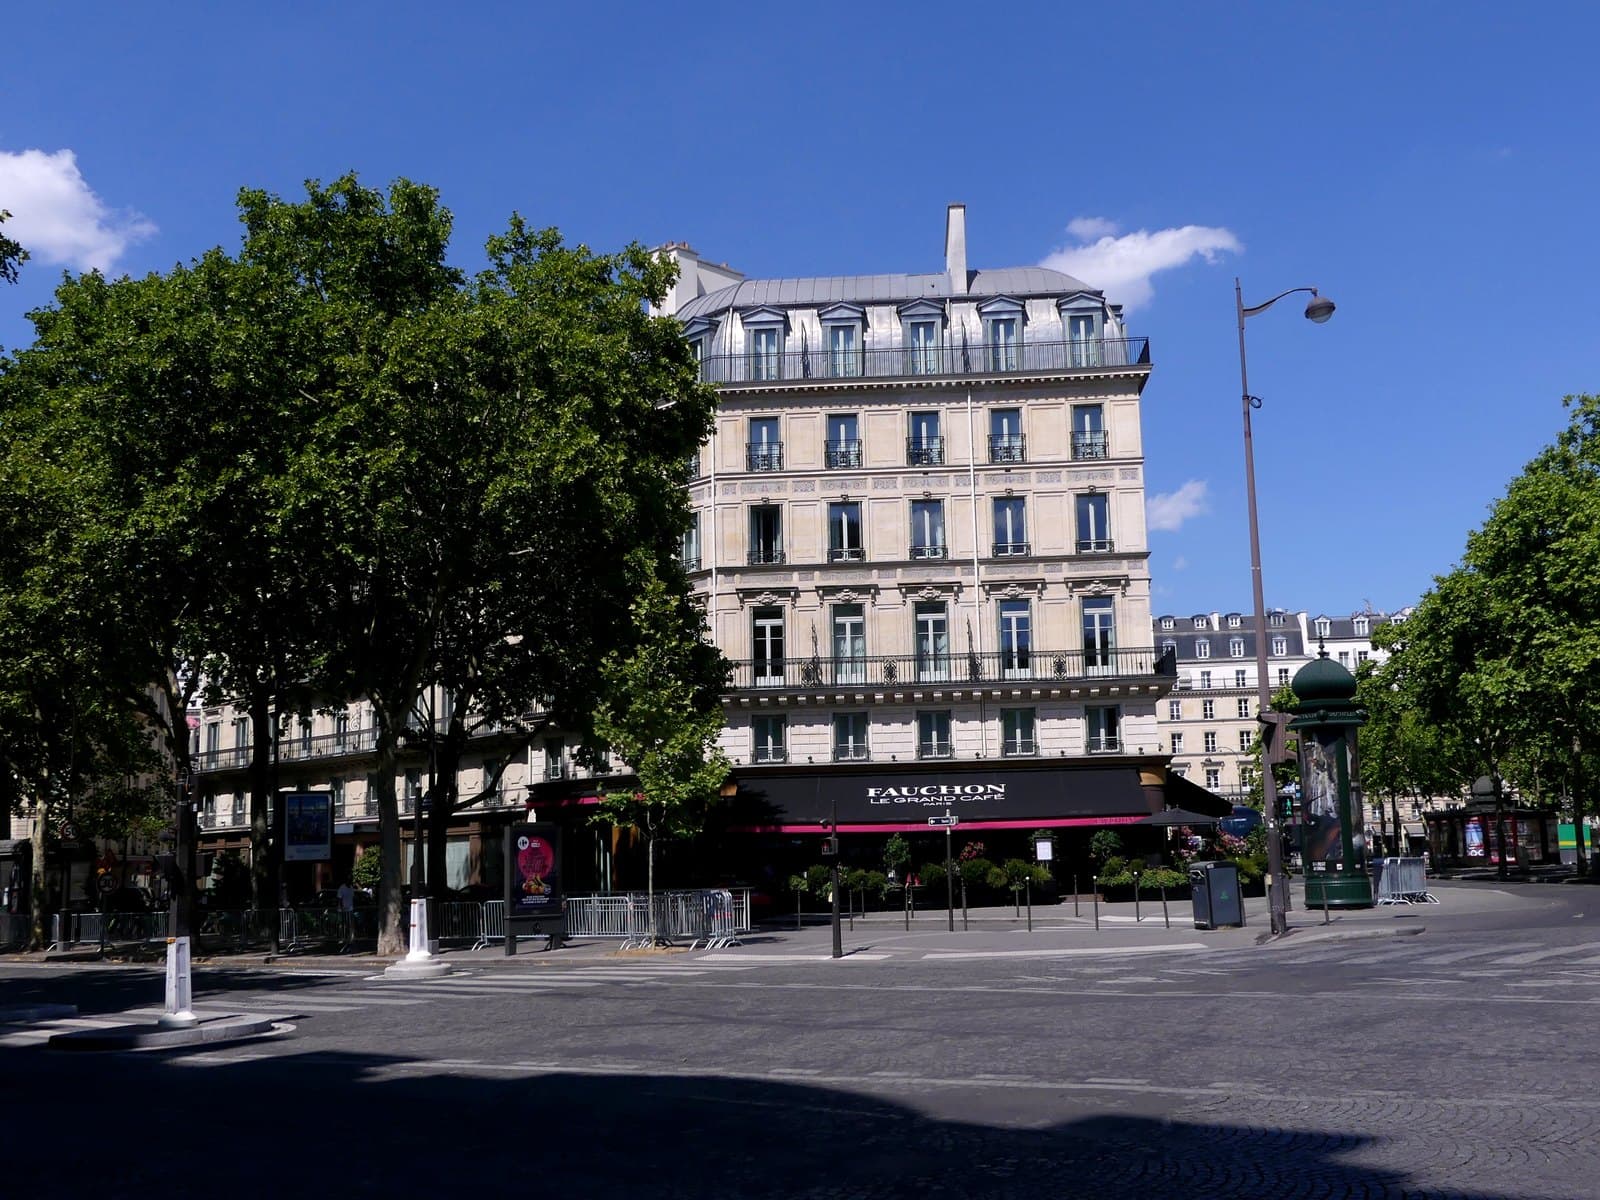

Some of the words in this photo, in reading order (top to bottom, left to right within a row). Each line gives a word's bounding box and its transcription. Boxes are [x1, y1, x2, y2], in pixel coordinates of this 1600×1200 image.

[867, 784, 1006, 797] FAUCHON
[894, 795, 956, 803] GRAND
[960, 793, 1005, 801] CAFÉ
[65, 827, 77, 836] 50
